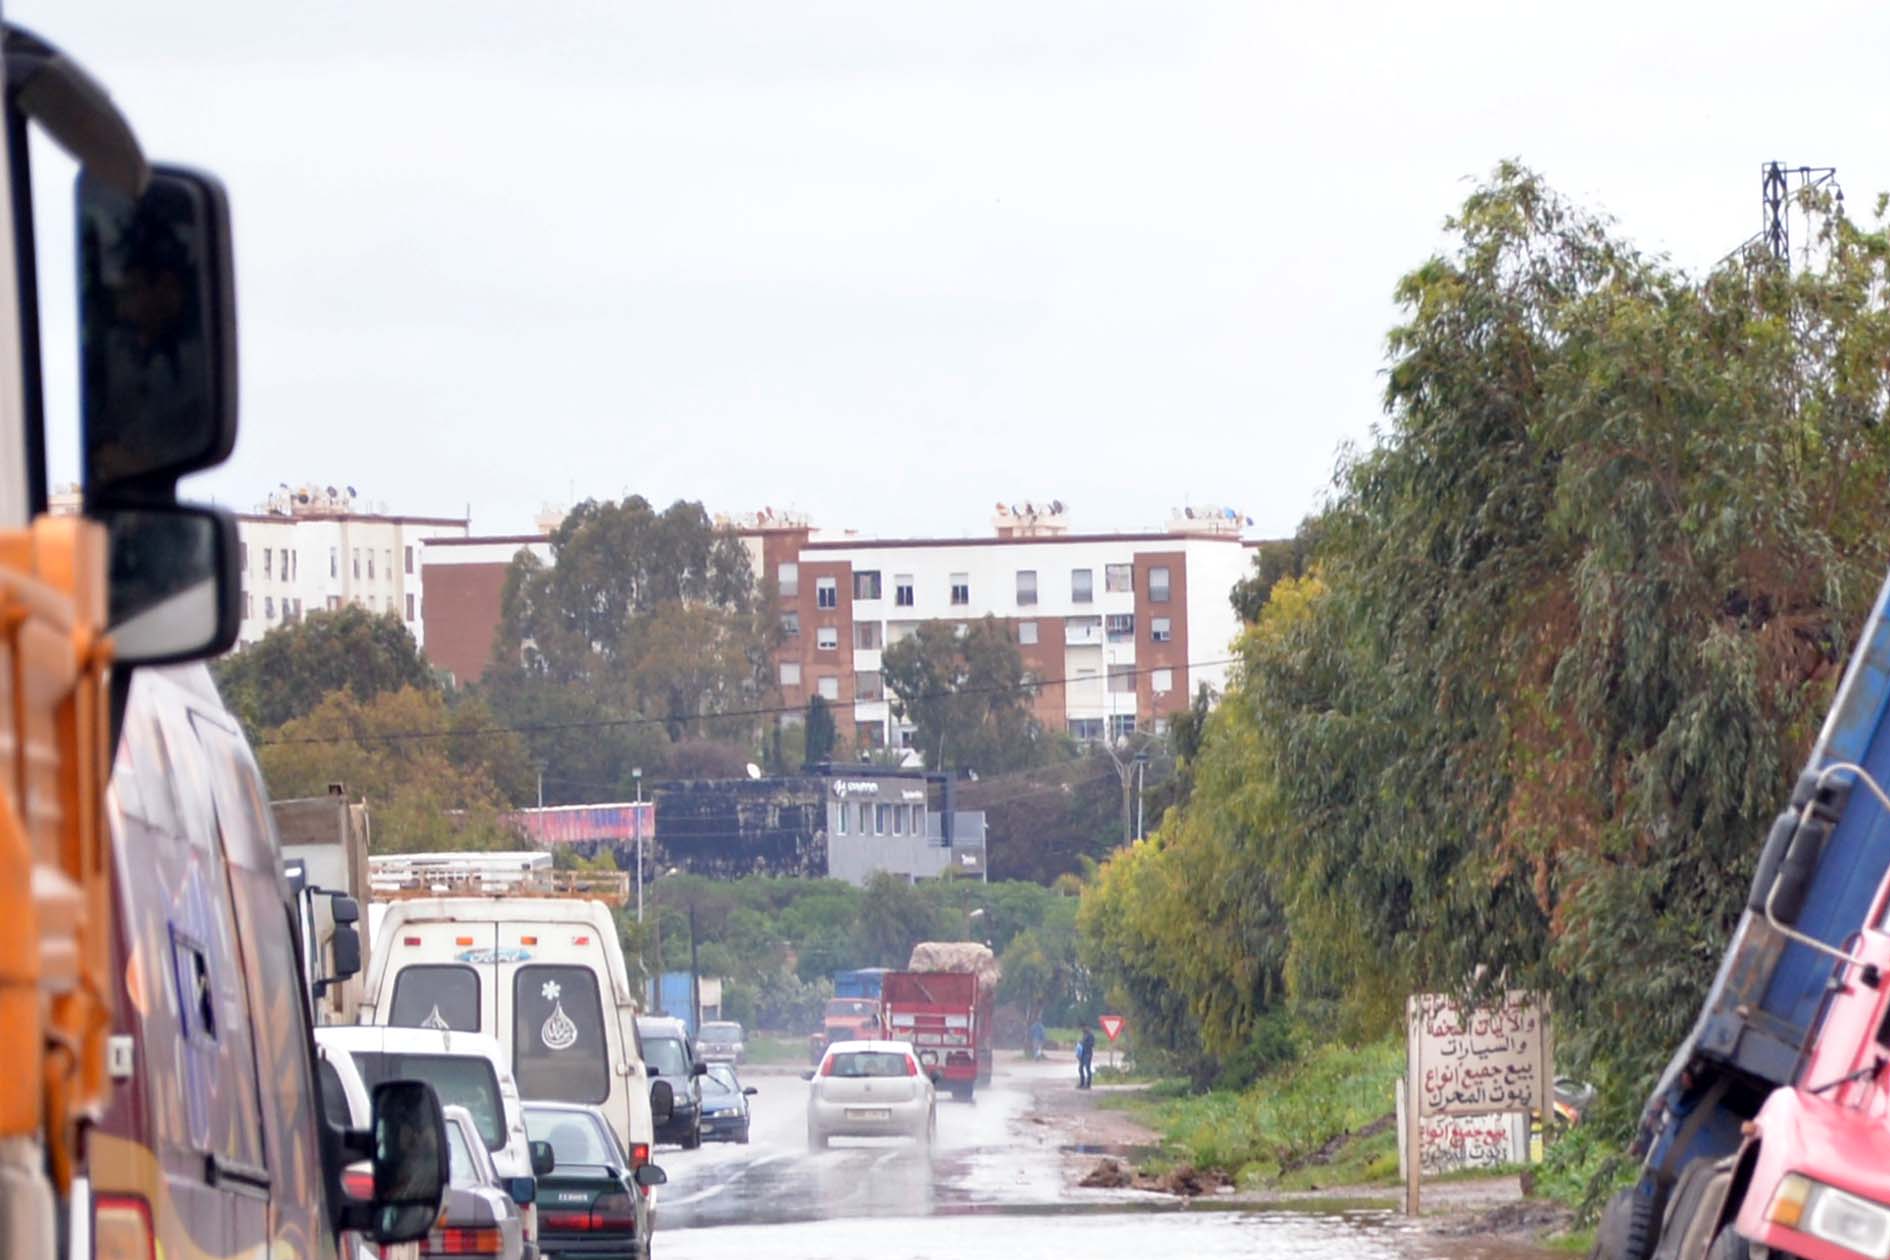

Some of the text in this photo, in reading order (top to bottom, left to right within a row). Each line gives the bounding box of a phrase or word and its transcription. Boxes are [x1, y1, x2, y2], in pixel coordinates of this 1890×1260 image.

[1440, 1036, 1527, 1061] والسيارات
[1461, 1065, 1502, 1090] جميع
[1504, 1063, 1534, 1086] بيع
